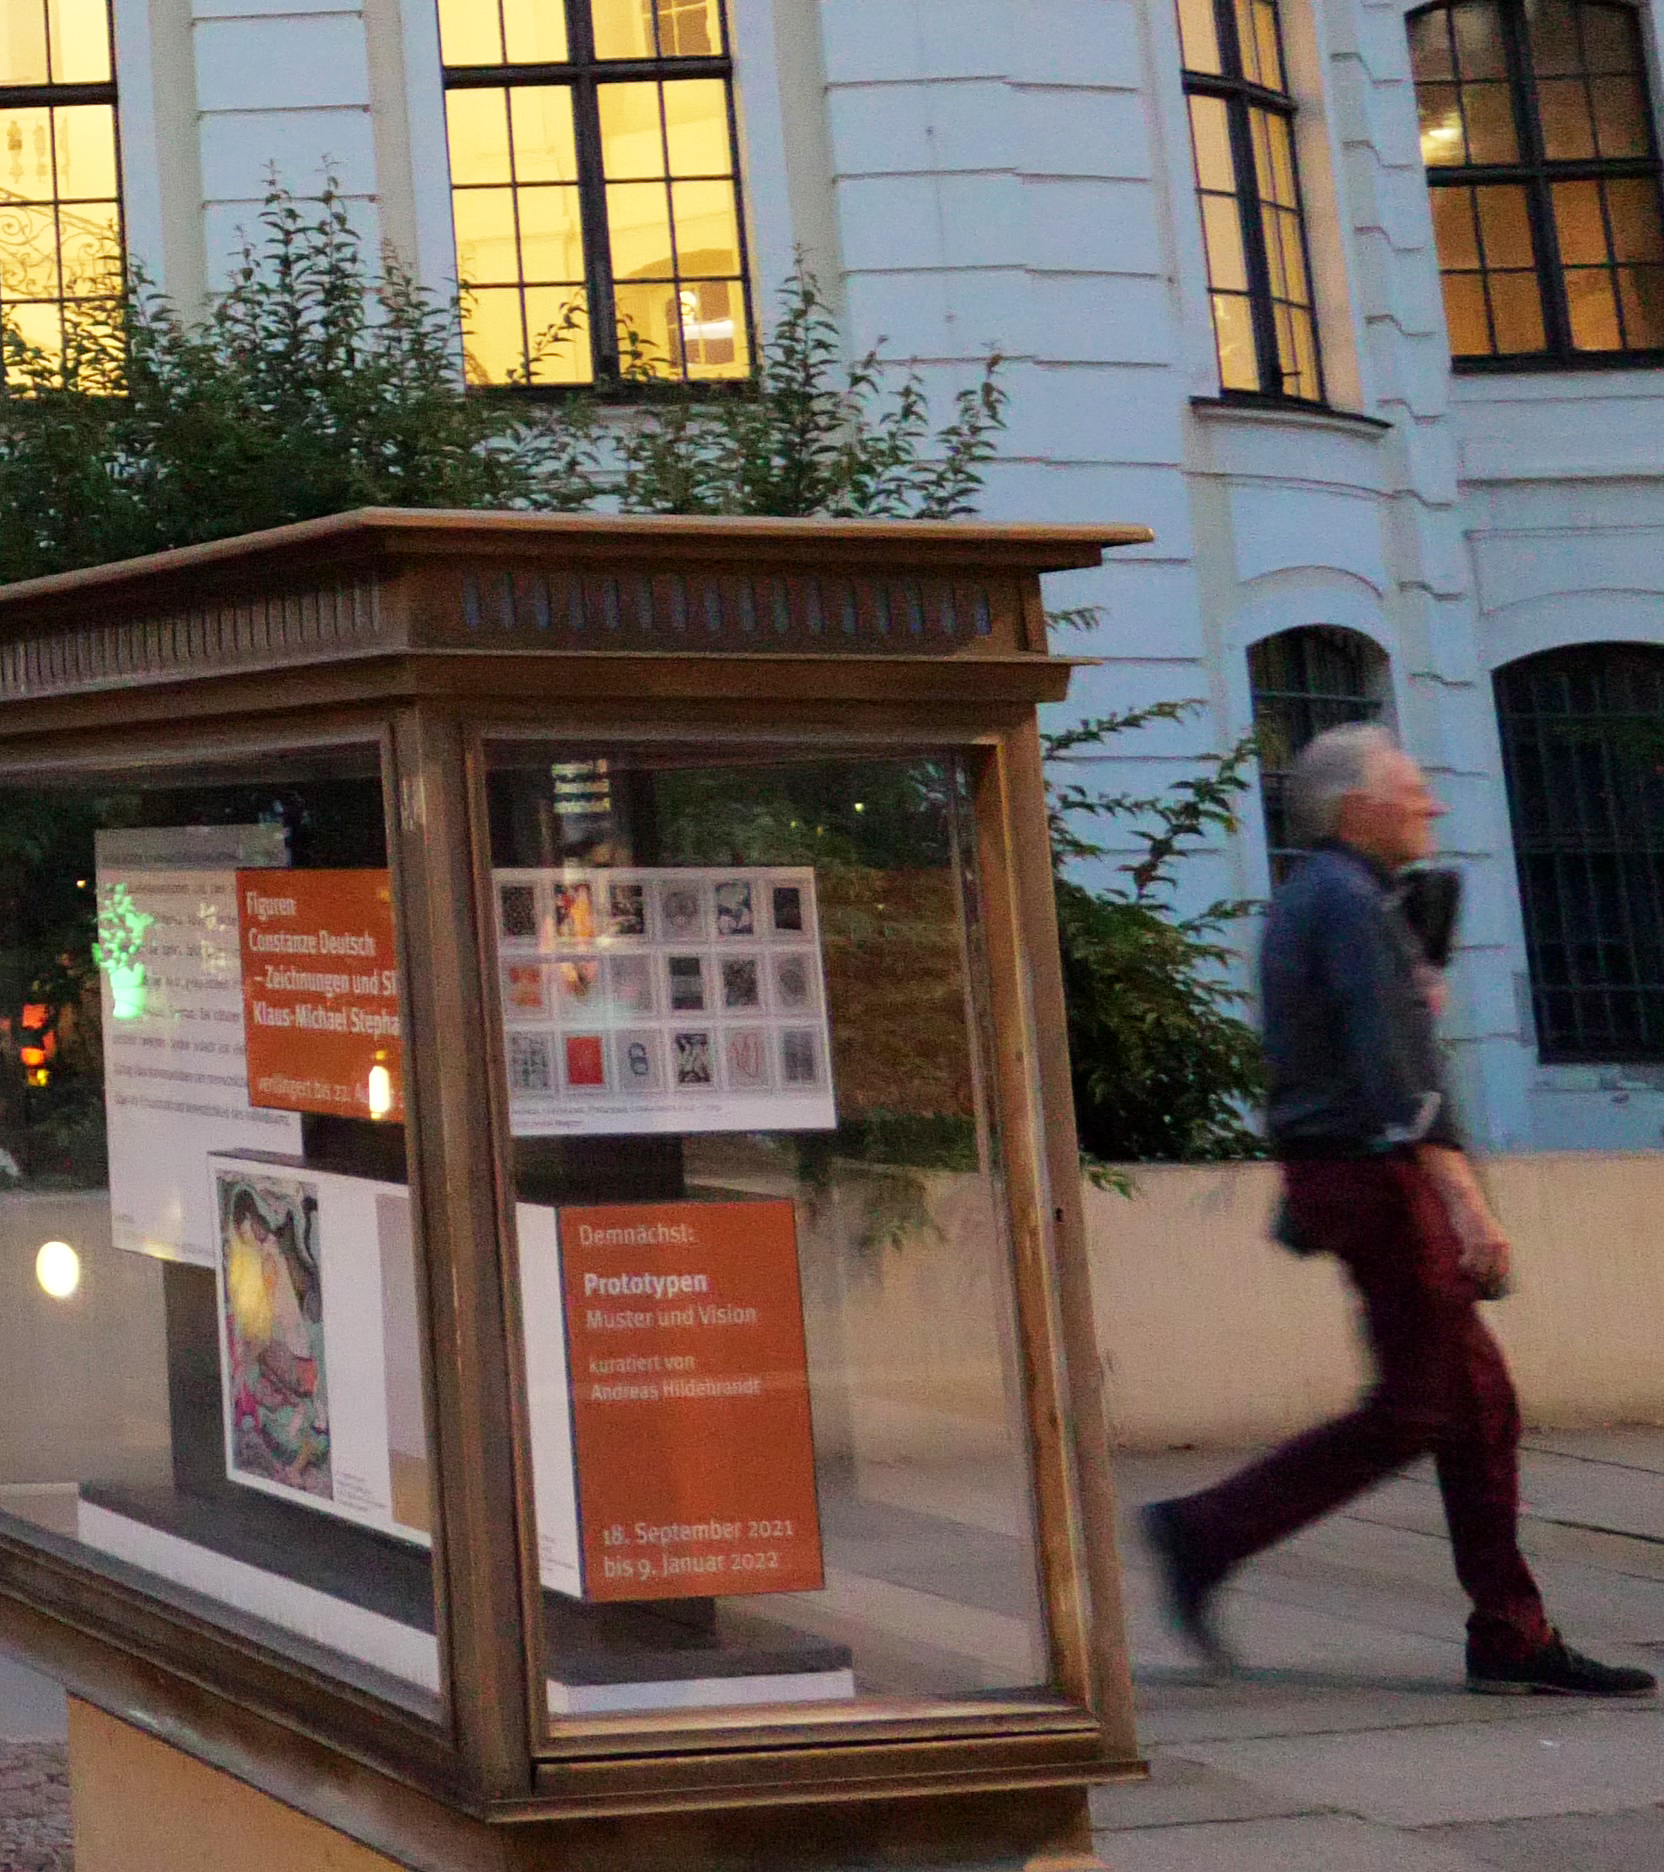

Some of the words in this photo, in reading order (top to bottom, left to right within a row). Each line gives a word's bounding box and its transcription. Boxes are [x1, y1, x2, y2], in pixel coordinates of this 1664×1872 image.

[246, 891, 297, 921] Figuren
[248, 927, 318, 955] Constanze
[319, 929, 376, 957] Deutsch
[352, 968, 379, 996] und
[253, 1000, 348, 1032] Klaus-Michael
[350, 1006, 402, 1040] Stepha
[579, 1222, 694, 1246] Demnächst:
[584, 1271, 709, 1300] Prototypen
[586, 1308, 655, 1329] Muster
[658, 1305, 694, 1327] und
[698, 1301, 758, 1326] Vision
[589, 1354, 661, 1375] kuratiert
[664, 1355, 696, 1372] von
[590, 1383, 660, 1402] Andreas
[603, 1524, 630, 1546] 18.
[635, 1518, 741, 1548] September
[747, 1519, 794, 1538] 2021
[603, 1554, 634, 1579] bis
[638, 1559, 657, 1581] 9.
[662, 1555, 725, 1578] Januar
[730, 1551, 780, 1571] 2022
